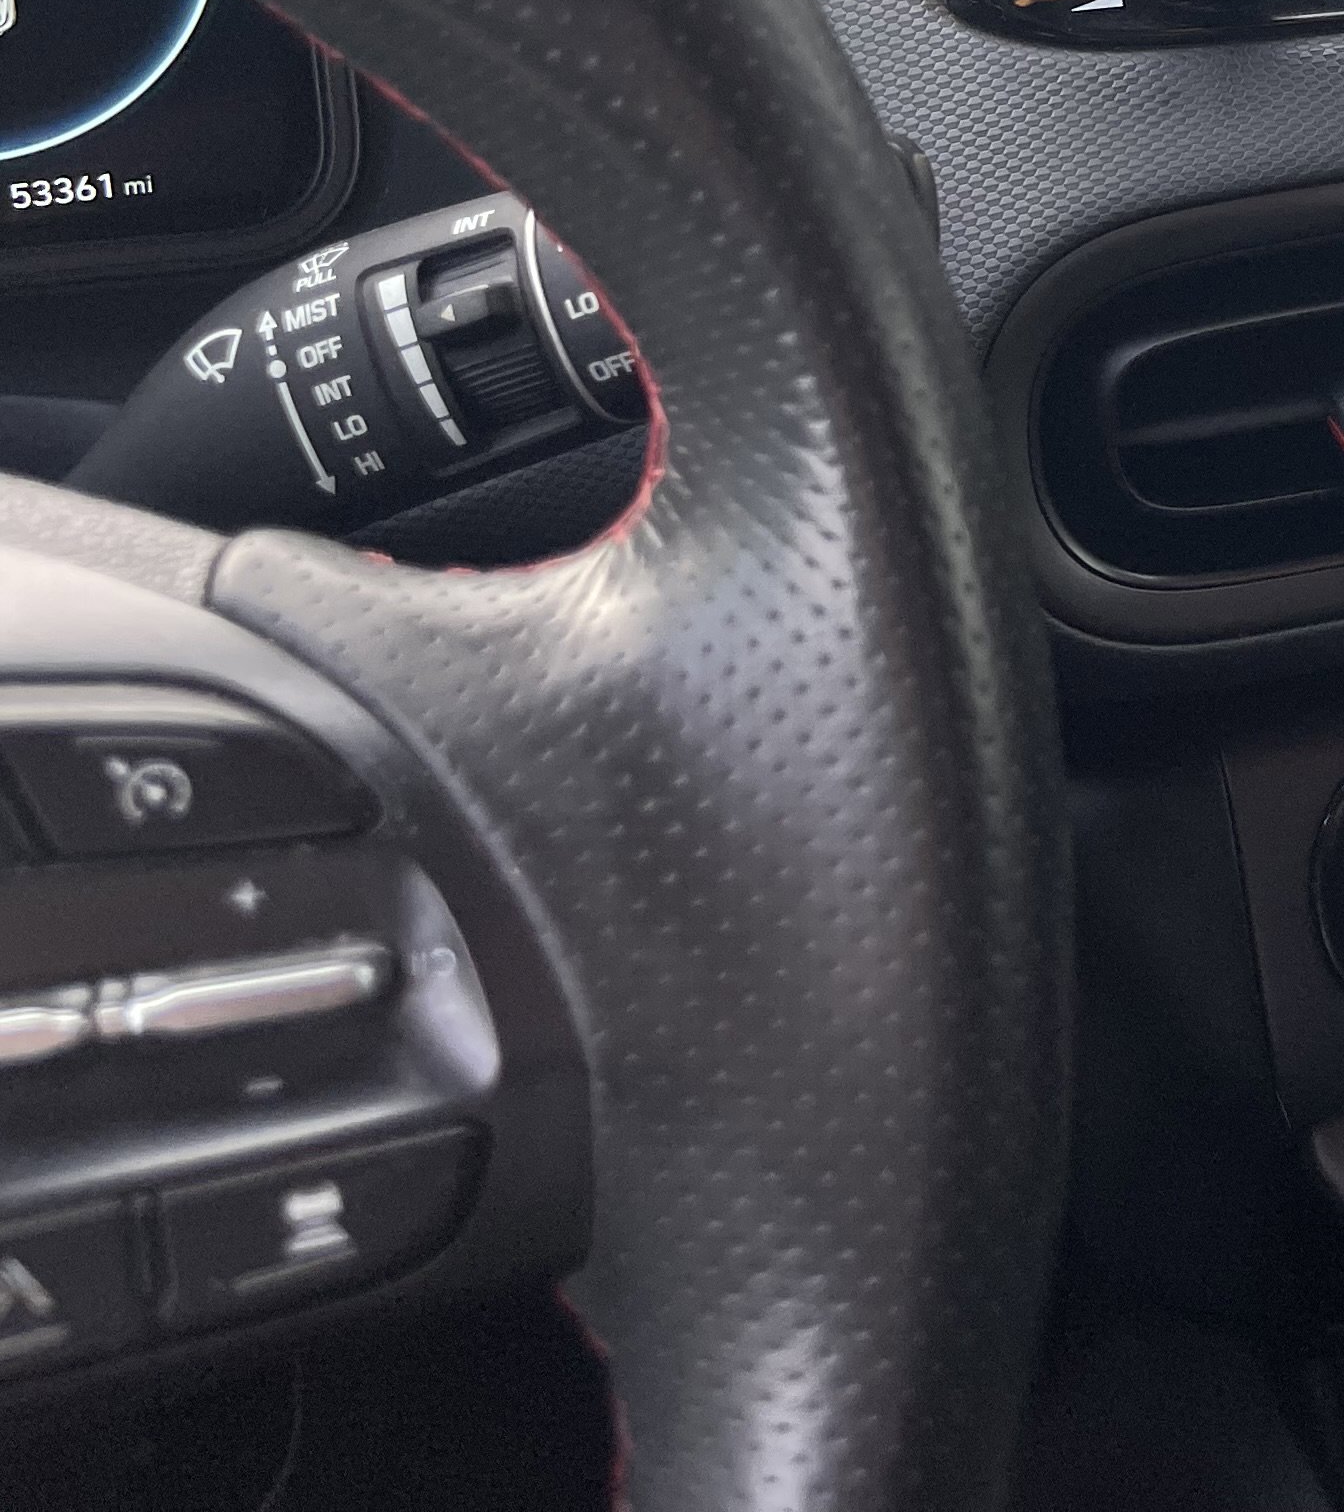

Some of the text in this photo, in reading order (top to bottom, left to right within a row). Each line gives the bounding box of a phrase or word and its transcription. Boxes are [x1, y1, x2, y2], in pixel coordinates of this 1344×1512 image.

[10, 174, 153, 210] 53361 mi
[453, 210, 495, 234] INT
[296, 269, 337, 293] PULL
[283, 293, 340, 332] MIST
[564, 292, 600, 320] LO
[298, 336, 343, 369] OFF
[588, 351, 635, 381] OFF
[313, 375, 352, 406] INT
[332, 414, 368, 441] LO
[354, 451, 386, 475] HI
